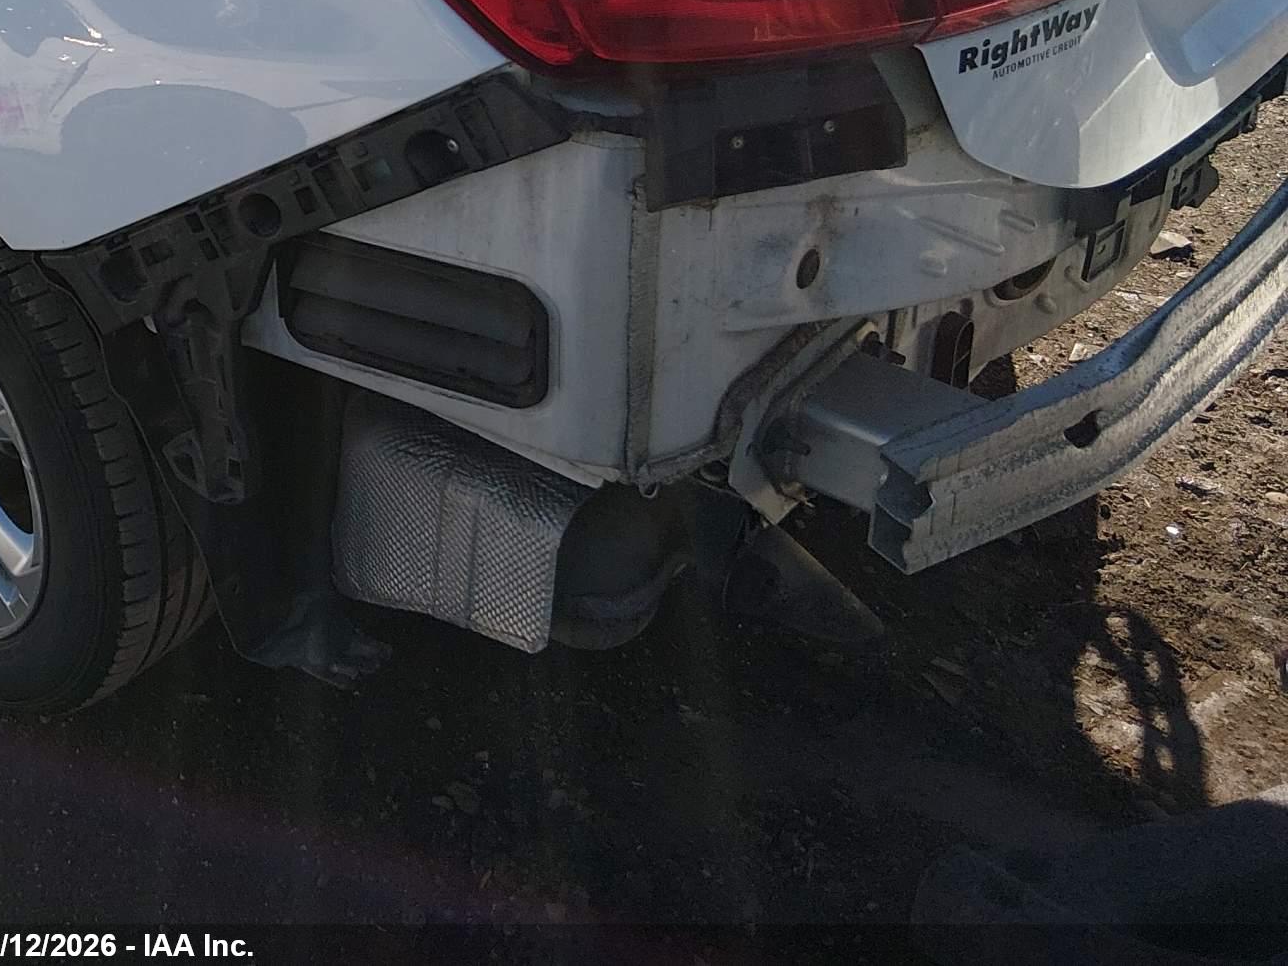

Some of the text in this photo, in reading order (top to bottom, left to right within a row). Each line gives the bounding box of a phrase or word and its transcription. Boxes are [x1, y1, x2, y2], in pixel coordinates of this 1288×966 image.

[958, 3, 1099, 74] RightWay
[992, 35, 1082, 80] AUTOMOTIVE CREDIT
